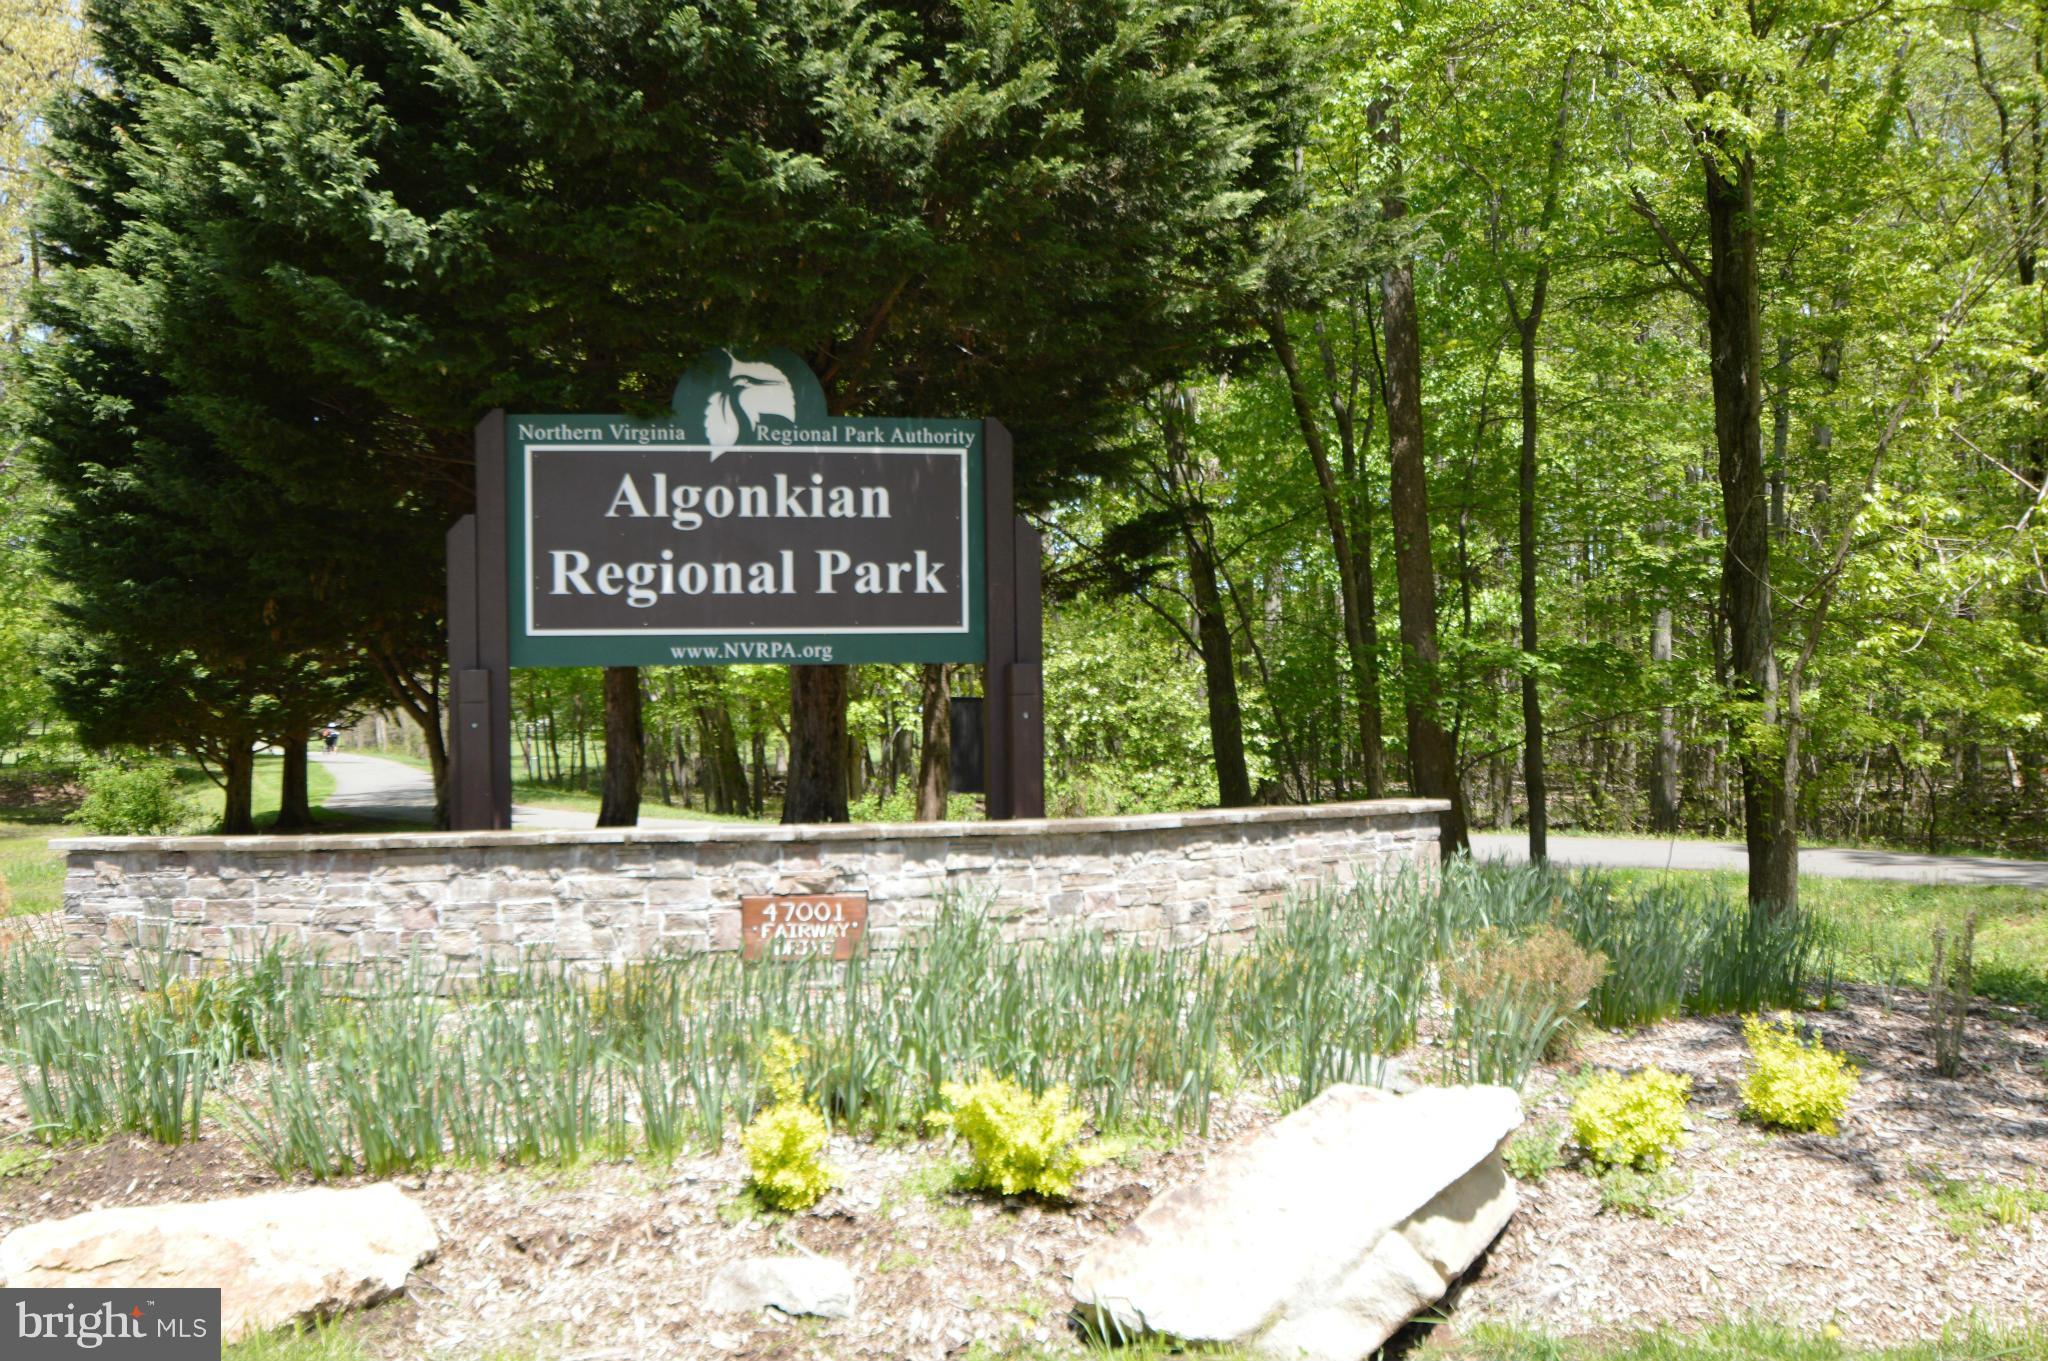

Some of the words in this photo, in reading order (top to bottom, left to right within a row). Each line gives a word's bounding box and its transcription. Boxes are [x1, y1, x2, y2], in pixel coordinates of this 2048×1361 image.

[518, 424, 603, 441] Northern
[609, 424, 686, 445] Virginia
[756, 425, 838, 446] Regional
[844, 426, 885, 443] Park
[890, 427, 976, 448] Authority
[605, 473, 892, 530] Algonkian
[549, 550, 797, 608] Regional
[815, 551, 947, 595] Park
[670, 641, 834, 662] www.NVRPA.org
[761, 901, 846, 922] 47001
[760, 921, 850, 939] FAIRWAY
